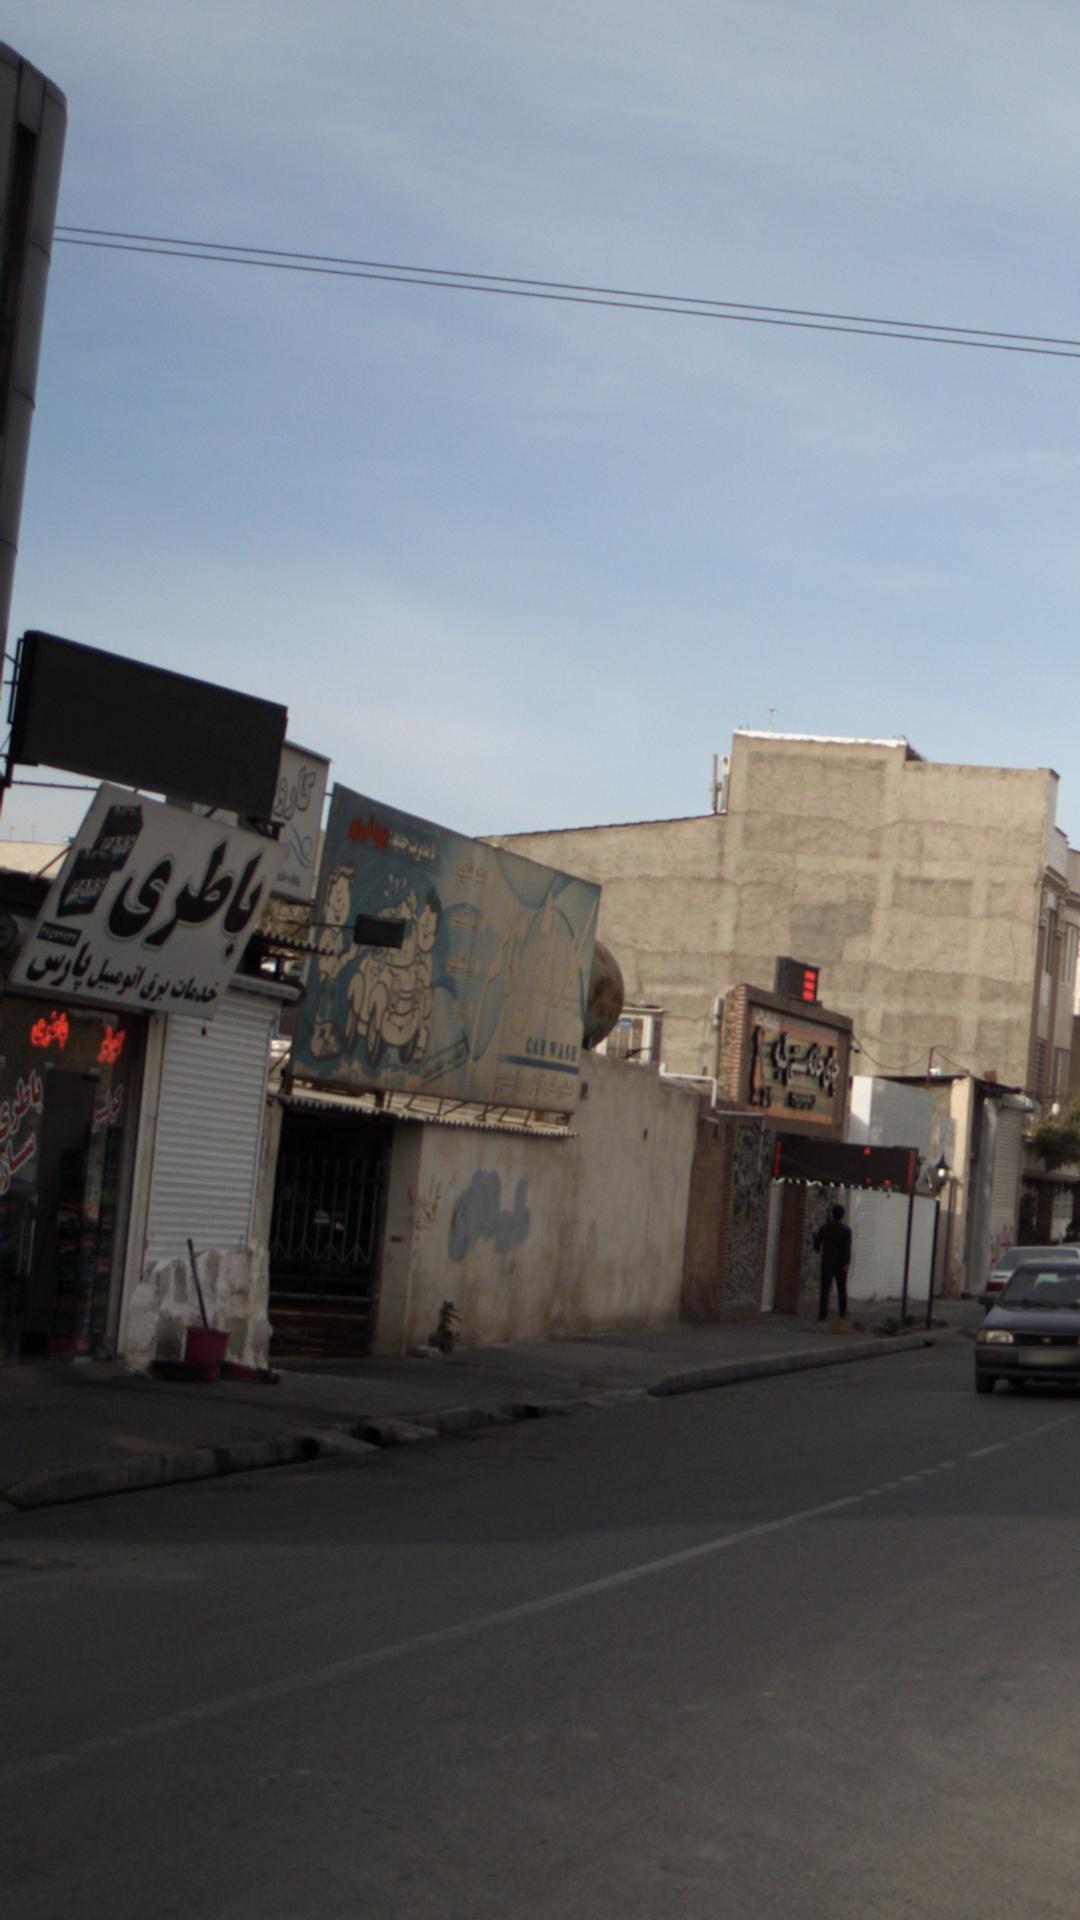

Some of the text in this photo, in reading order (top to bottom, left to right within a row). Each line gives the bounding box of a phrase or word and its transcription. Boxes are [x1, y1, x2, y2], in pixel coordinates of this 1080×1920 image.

[106, 834, 264, 957] باطری
[26, 942, 219, 1003] خدمات برق اتومبیل پارس
[526, 1037, 577, 1061] CAR WASH
